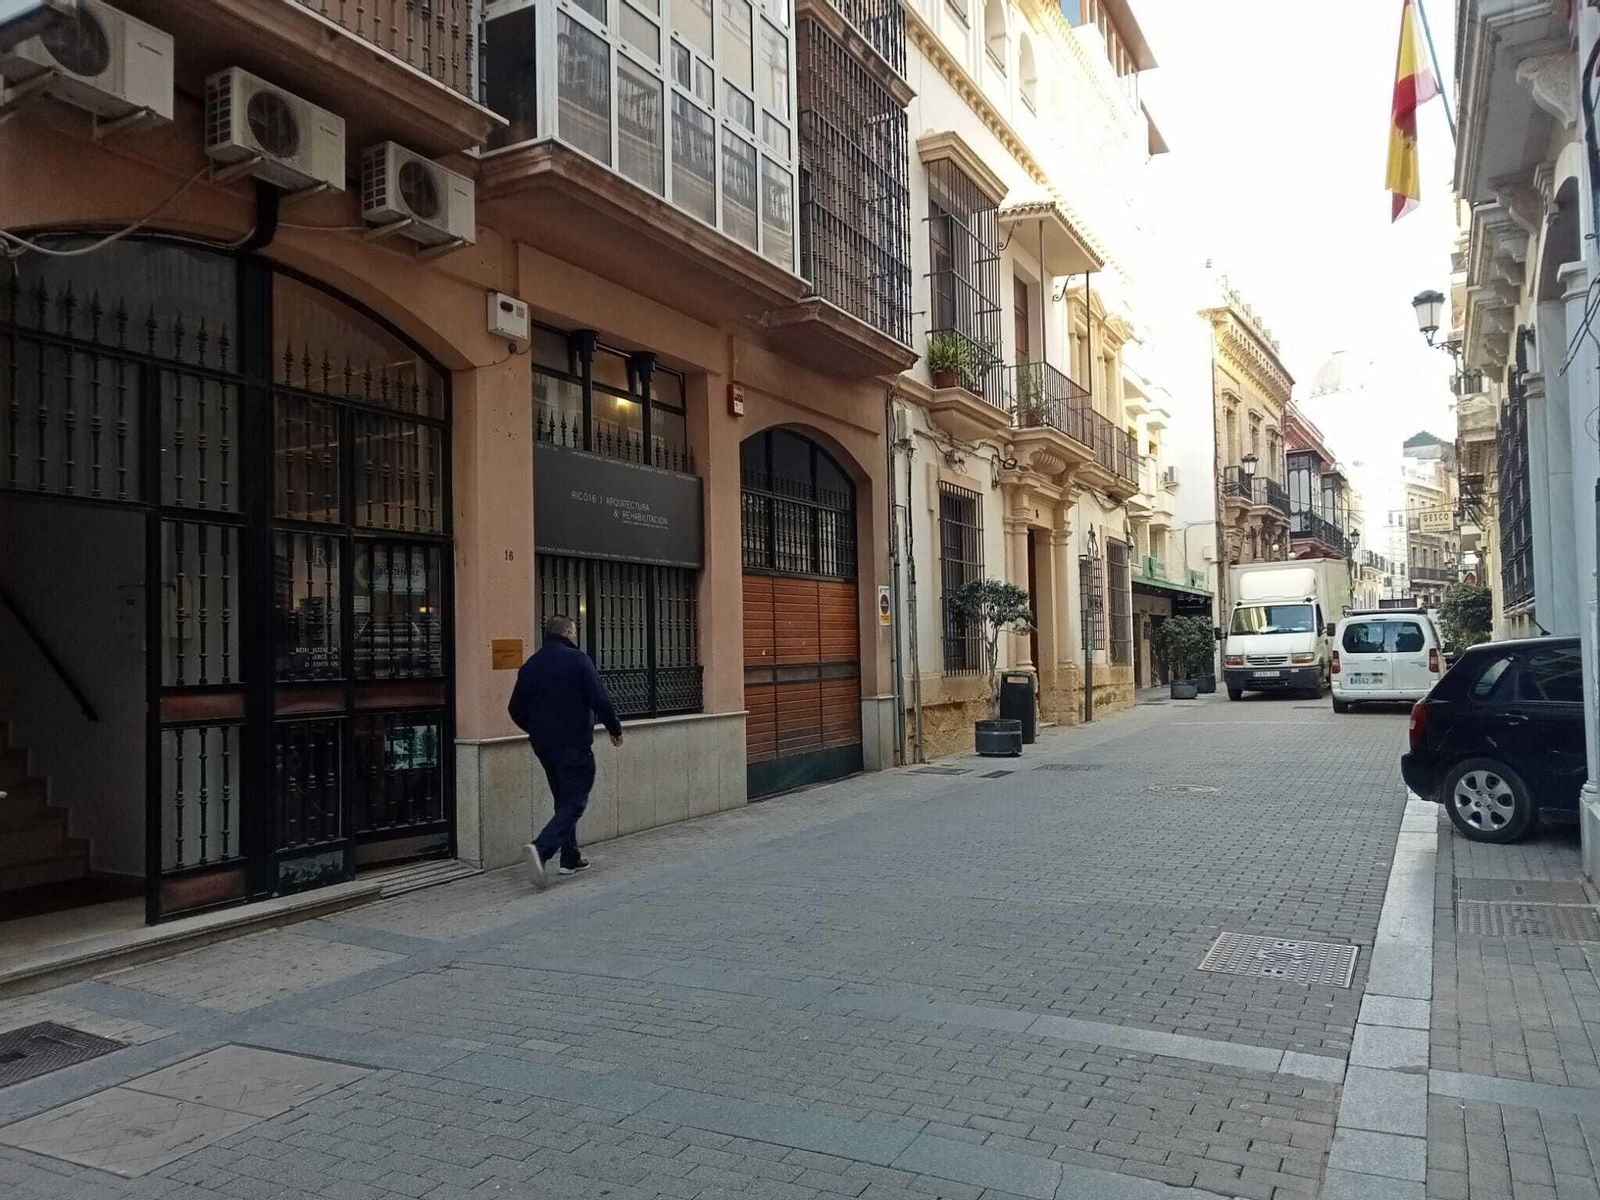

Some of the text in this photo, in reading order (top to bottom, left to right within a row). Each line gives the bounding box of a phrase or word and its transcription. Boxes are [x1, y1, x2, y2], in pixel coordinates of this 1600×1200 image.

[605, 496, 650, 511] ARQUITECTURA
[613, 509, 620, 518] &
[1423, 512, 1449, 522] GESCO
[504, 549, 514, 562] 16
